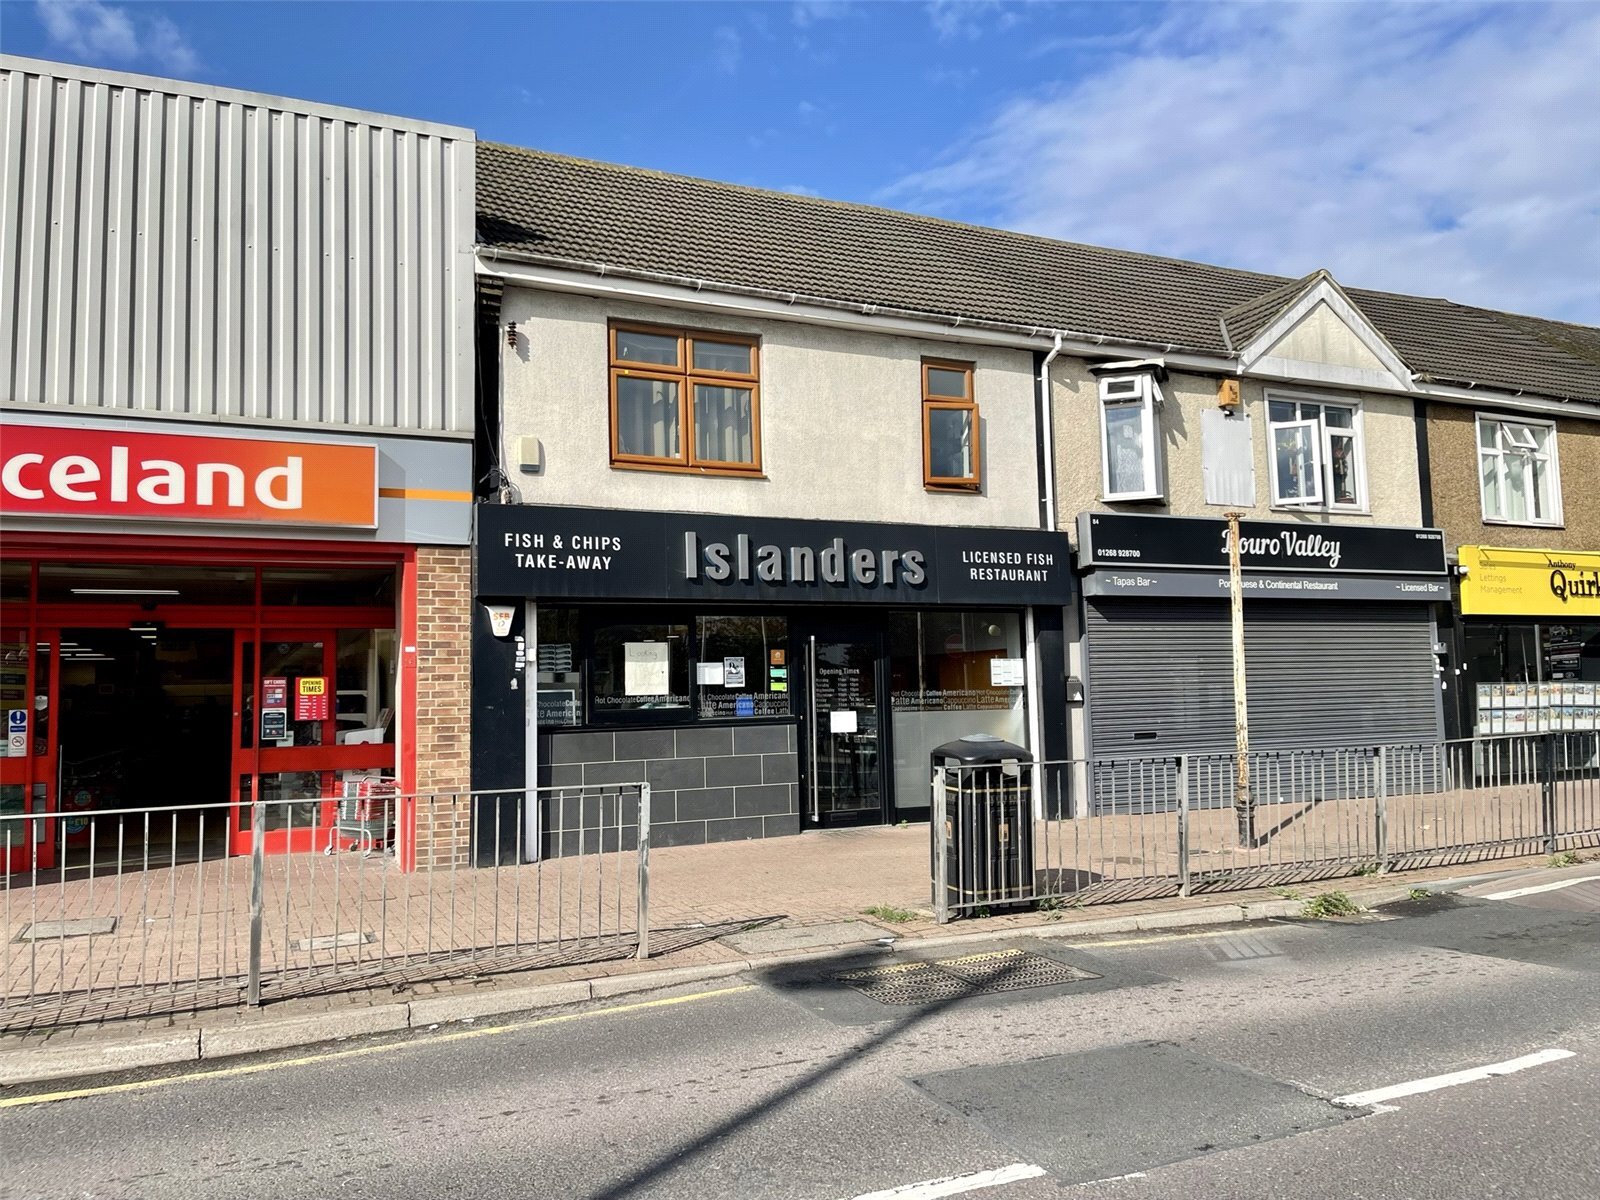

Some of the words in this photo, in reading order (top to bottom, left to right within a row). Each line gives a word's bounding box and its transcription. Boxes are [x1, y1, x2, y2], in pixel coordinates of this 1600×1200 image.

[1, 446, 303, 510] celand
[504, 533, 544, 549] FISH
[552, 534, 563, 549] &
[571, 535, 621, 551] CHIPS
[1097, 548, 1117, 557] 01268
[1117, 549, 1141, 557] 928700
[1280, 531, 1341, 568] Valley
[515, 553, 612, 570] TAKE-AWAY
[684, 531, 926, 585] Islanders
[962, 550, 1021, 565] LICENSED
[1026, 553, 1054, 566] FISH
[1547, 559, 1576, 571] Anthony
[970, 567, 1048, 582] RESTAURANT
[1479, 573, 1507, 584] Lettings
[1112, 576, 1136, 588] Tapas
[1136, 576, 1150, 587] Bar
[1218, 578, 1258, 589] Poruese
[1258, 579, 1265, 589] &
[1265, 579, 1302, 590] Continental
[1303, 580, 1339, 590] Restaurant
[1401, 582, 1428, 592] Licensed
[1428, 583, 1439, 592] Bar
[1479, 585, 1523, 595] Management
[819, 667, 843, 676] Opening
[843, 667, 860, 675] Times
[302, 685, 322, 693] TIMES
[943, 689, 976, 697] Americano
[606, 695, 636, 704] Chocolate
[636, 695, 654, 703] Coffee
[706, 693, 735, 701] Chocolate
[976, 695, 995, 704] Latte
